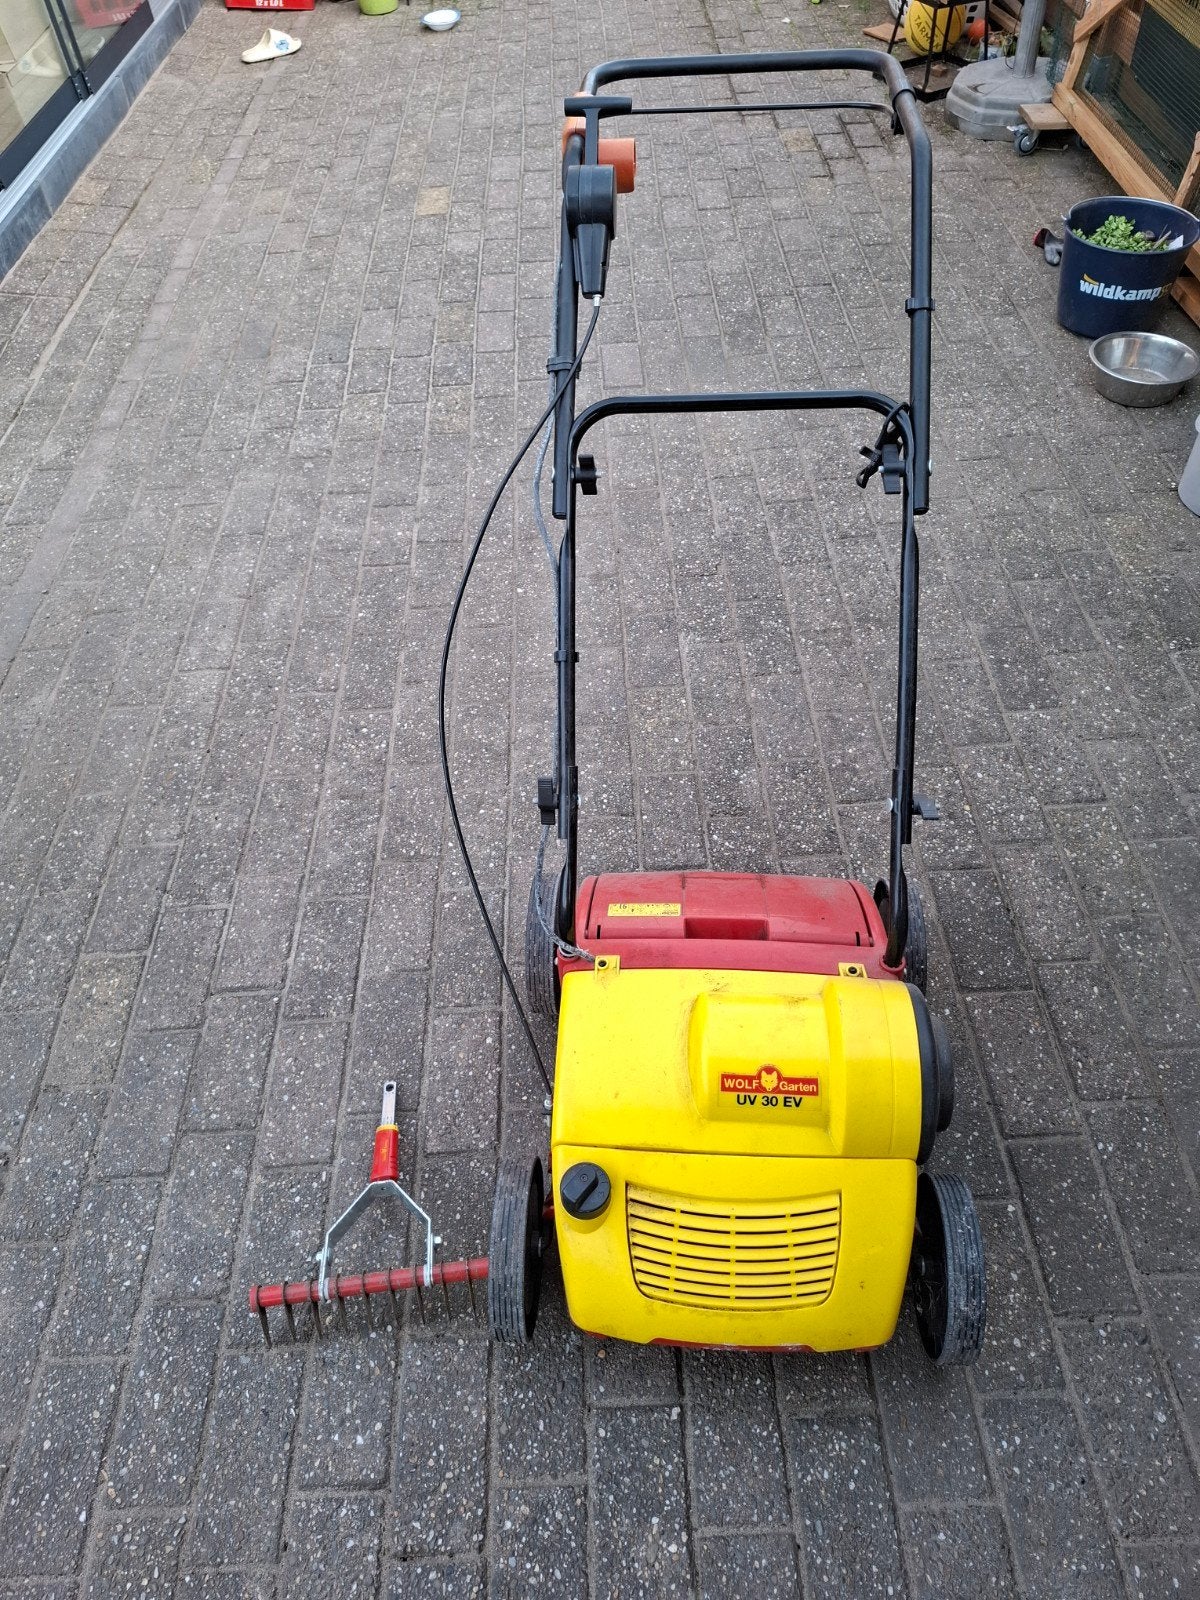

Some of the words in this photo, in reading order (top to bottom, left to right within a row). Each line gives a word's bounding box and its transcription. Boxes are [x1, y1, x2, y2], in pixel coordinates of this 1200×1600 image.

[914, 15, 942, 49] TARMK
[1080, 279, 1162, 301] wildkamp
[723, 1078, 760, 1090] WOLF
[779, 1081, 817, 1093] Garten
[736, 1094, 758, 1106] UV
[761, 1095, 779, 1107] 30
[783, 1096, 803, 1108] EV
